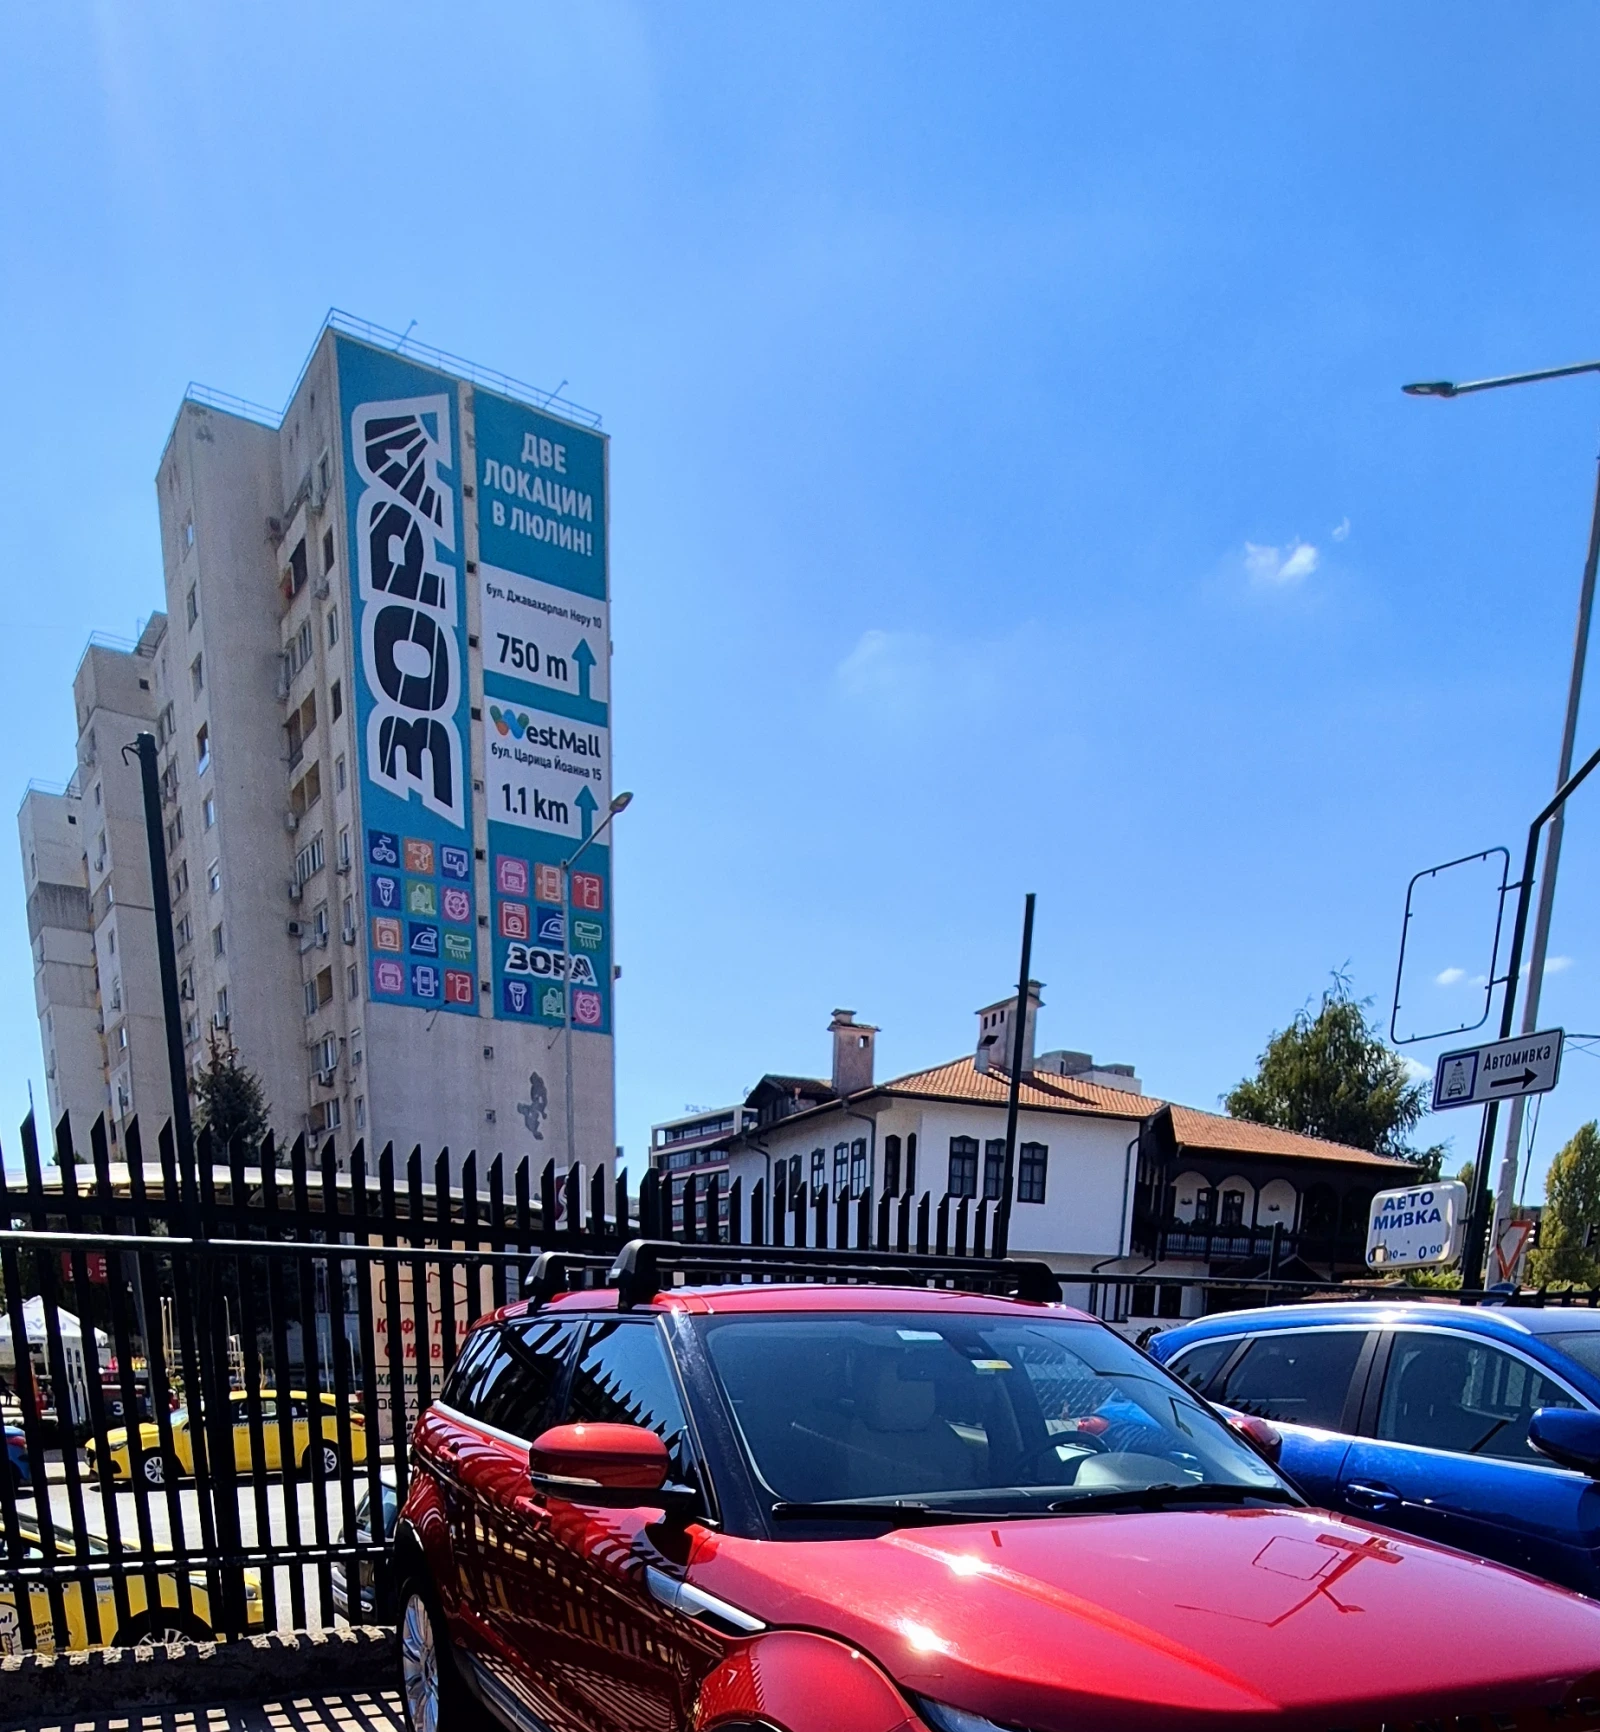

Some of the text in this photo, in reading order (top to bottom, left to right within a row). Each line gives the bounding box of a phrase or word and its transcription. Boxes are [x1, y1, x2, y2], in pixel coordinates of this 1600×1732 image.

[521, 432, 567, 474] ДВЕ
[483, 458, 592, 522] ЛОКАЦИИ
[492, 500, 592, 557] В ЛЮЛИН!
[352, 393, 466, 829] ЗОРА
[486, 583, 505, 599] бул.
[570, 608, 591, 628] Неру
[592, 616, 602, 629] 10
[496, 631, 540, 673] 750
[489, 705, 601, 758] WestMall
[491, 742, 602, 781] бул. Царица Йоанна 15
[502, 783, 569, 824] 1.1 km
[504, 942, 599, 987] ЗОРА
[1482, 1045, 1551, 1072] Автомивка
[1373, 1207, 1442, 1230] МИВКА
[1382, 1191, 1435, 1211] АВТО
